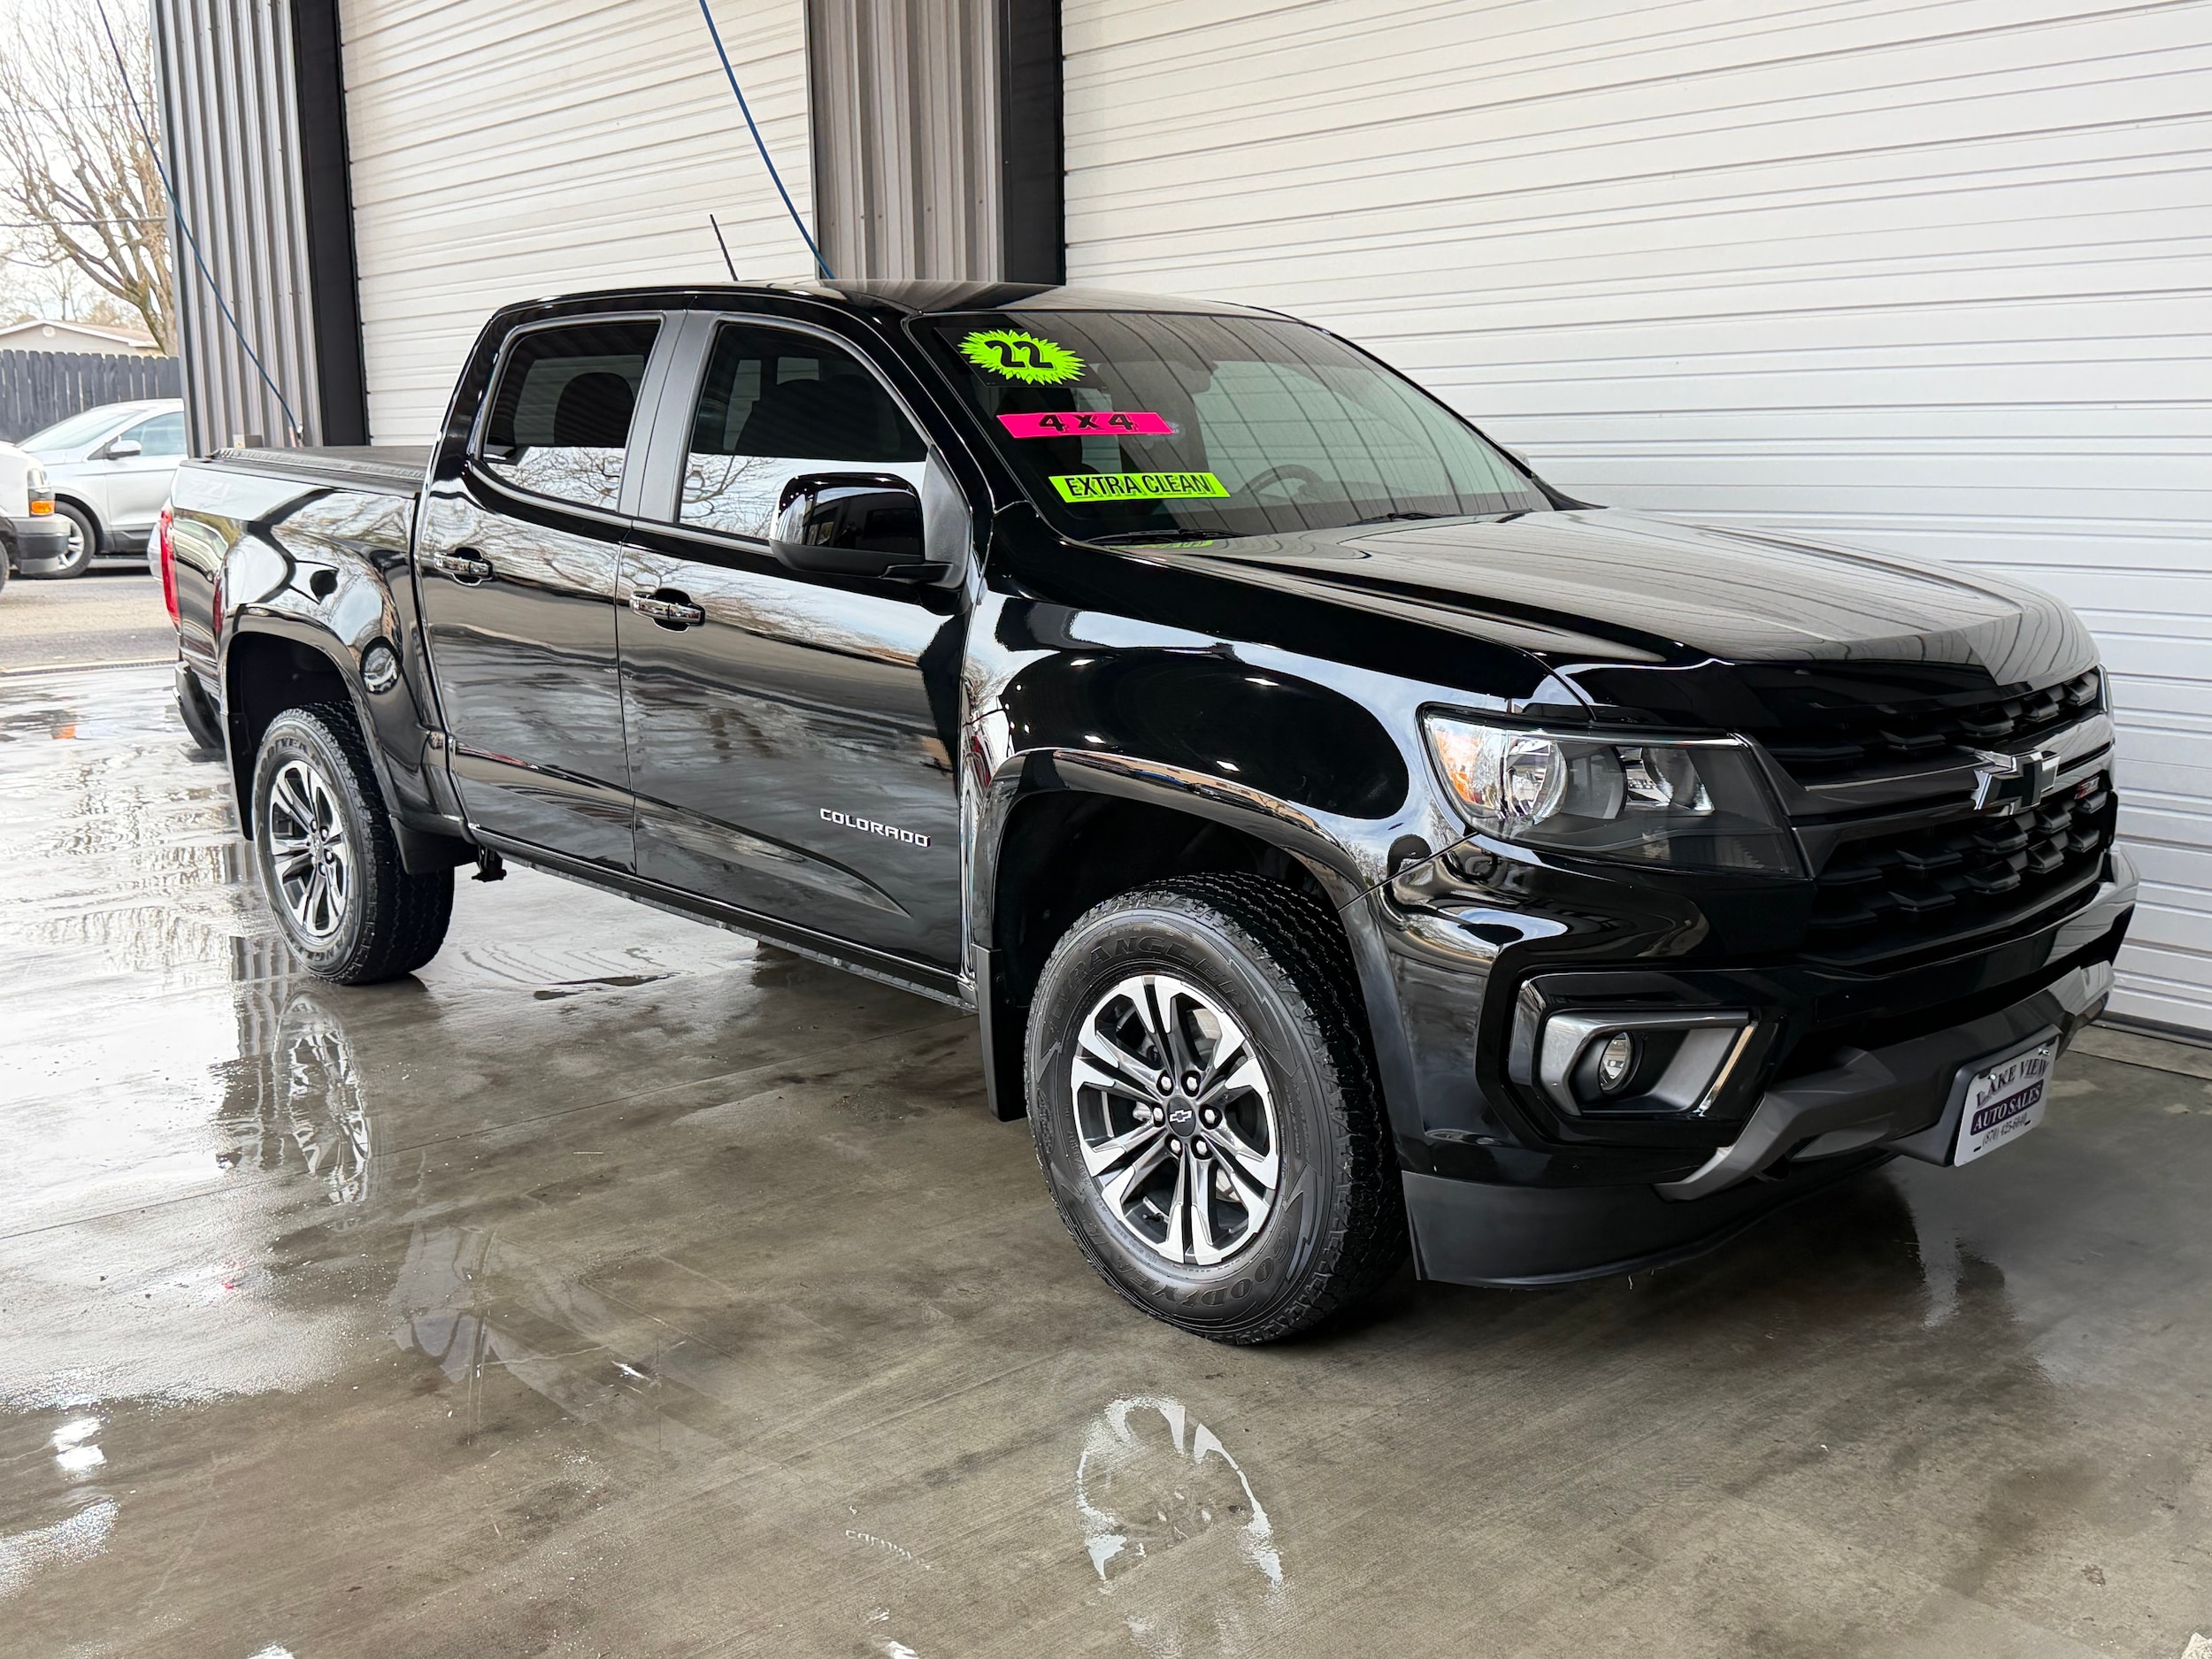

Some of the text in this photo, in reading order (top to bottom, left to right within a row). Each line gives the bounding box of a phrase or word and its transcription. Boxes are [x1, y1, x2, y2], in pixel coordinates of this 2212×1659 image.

[984, 340, 1054, 370] 22
[1064, 474, 1213, 496] EXTRA CLEAN
[819, 808, 931, 848] COLORADO
[1976, 1058, 2049, 1108] LAKE VIEW
[1973, 1085, 2040, 1132] AUTO SALES
[1082, 1218, 1291, 1309] GOODYEAR
